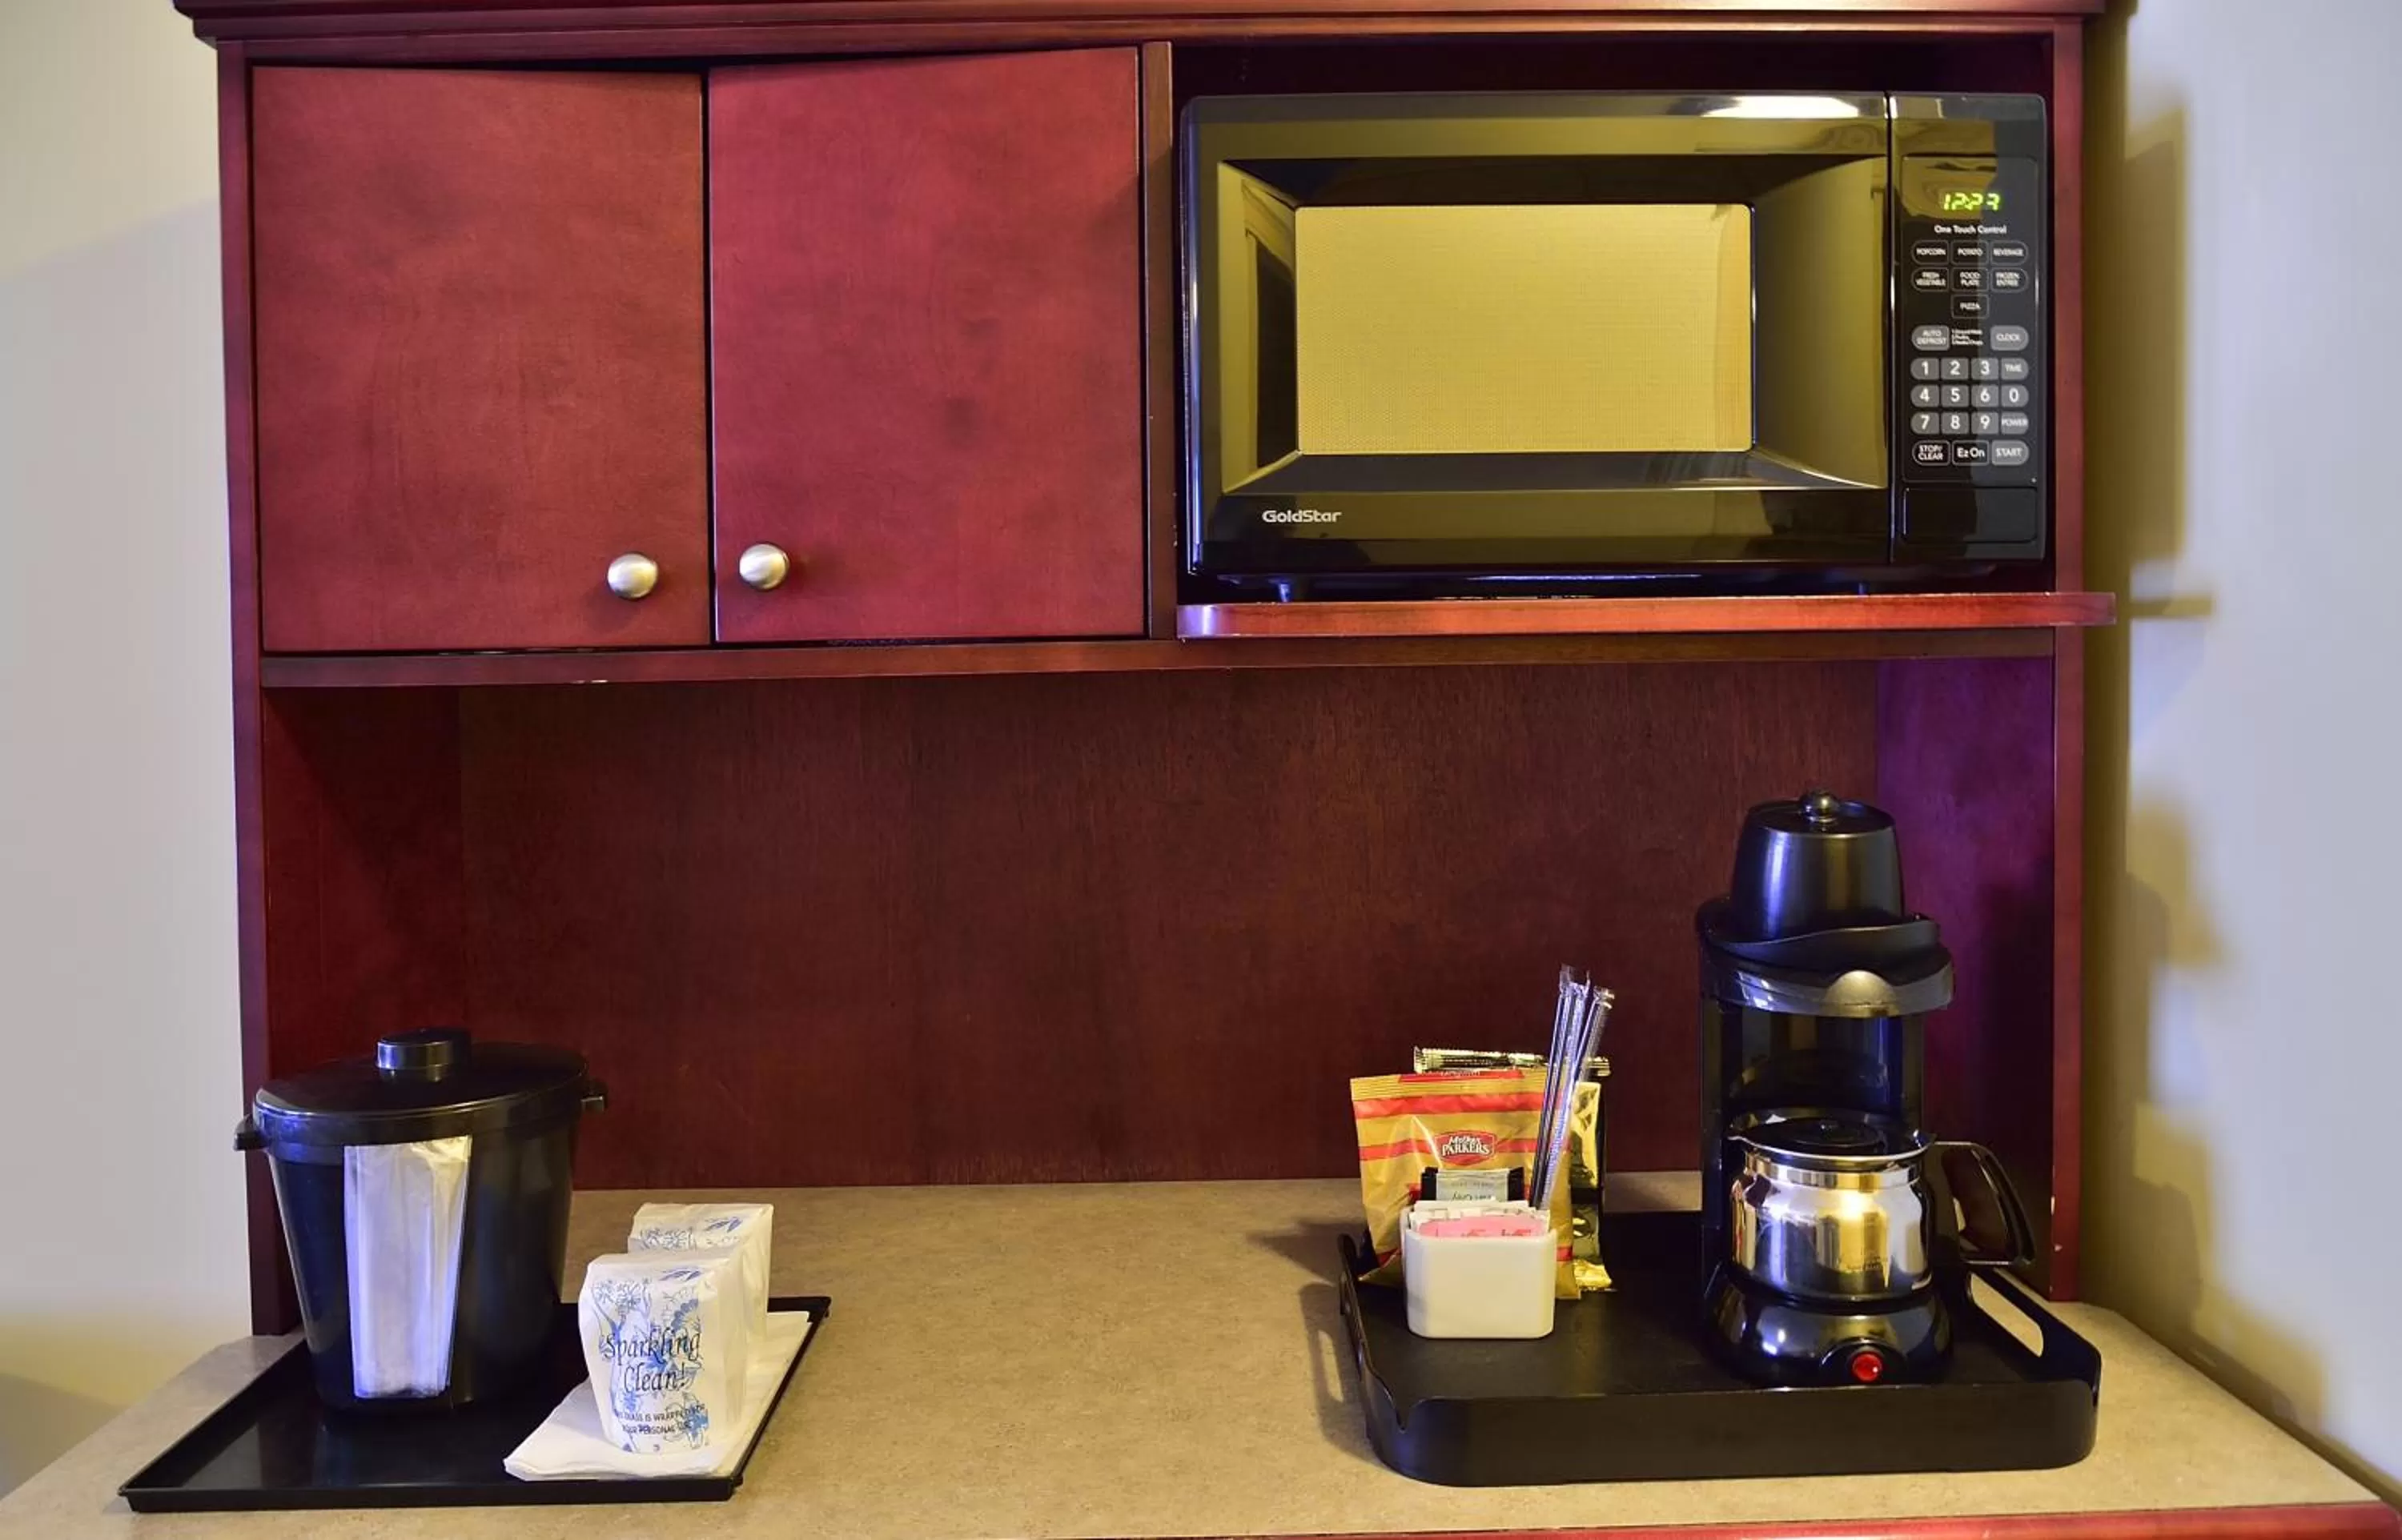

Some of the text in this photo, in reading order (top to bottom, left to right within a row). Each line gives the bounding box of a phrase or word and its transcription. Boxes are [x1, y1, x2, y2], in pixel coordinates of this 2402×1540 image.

[1934, 225, 2007, 234] One Touch Control
[1996, 333, 2021, 342] CLOCK
[1922, 361, 1929, 375] 1
[1950, 361, 1961, 375] 2
[1980, 361, 1990, 375] 3
[2004, 363, 2022, 372] TIME
[1920, 387, 1930, 402] 4
[1950, 387, 1961, 403] 5
[1980, 387, 1990, 403] 6
[2009, 387, 2019, 403] 0
[1921, 415, 1930, 430] 7
[1950, 415, 1961, 430] 8
[1980, 415, 1990, 430] 9
[2002, 418, 2028, 427] POWER
[1918, 452, 1943, 460] CLEAR
[1970, 448, 1985, 458] On
[1995, 448, 2022, 457] START
[1262, 510, 1342, 523] GoldStar
[1442, 1144, 1490, 1157] PARKERS
[604, 1324, 702, 1366] Sparkling
[624, 1363, 686, 1391] Clean!
